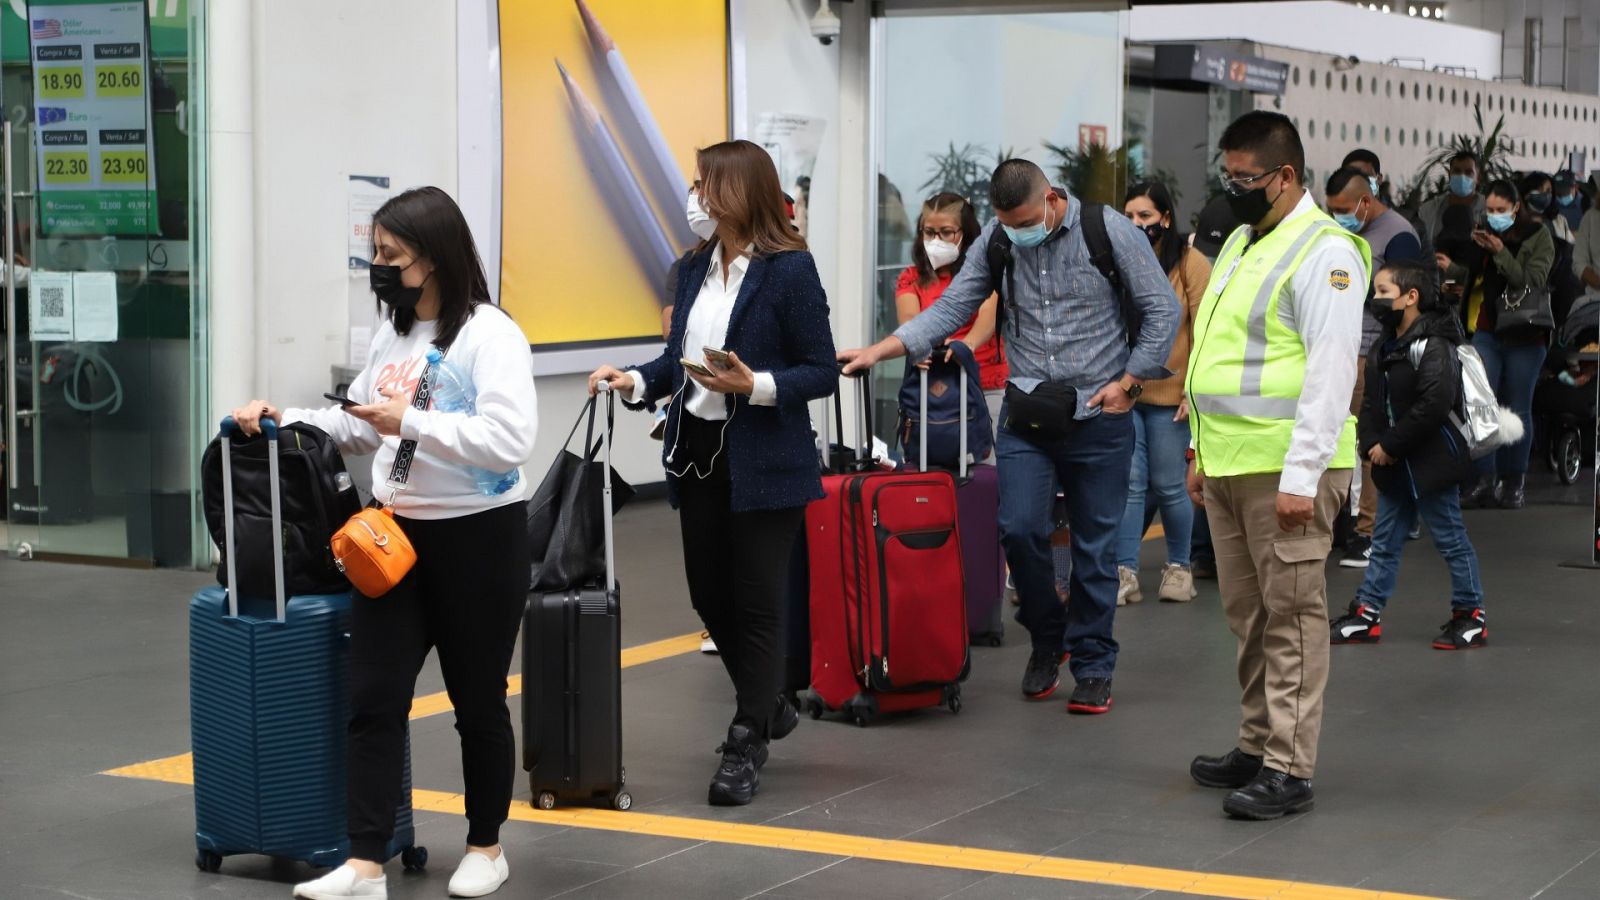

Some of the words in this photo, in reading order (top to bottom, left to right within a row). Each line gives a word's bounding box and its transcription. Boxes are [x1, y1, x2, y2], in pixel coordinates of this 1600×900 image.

[39, 49, 63, 58] Compra
[68, 49, 79, 58] Buy
[100, 47, 118, 55] Venta
[123, 46, 134, 54] Sell
[41, 73, 82, 90] 18.90
[98, 71, 140, 88] 20.60
[69, 113, 87, 122] Euro
[44, 134, 68, 143] Compra
[73, 134, 85, 143] Buy
[106, 133, 123, 142] Venta
[128, 132, 139, 141] Sell
[47, 159, 87, 175] 22.30
[103, 159, 145, 174] 23.90
